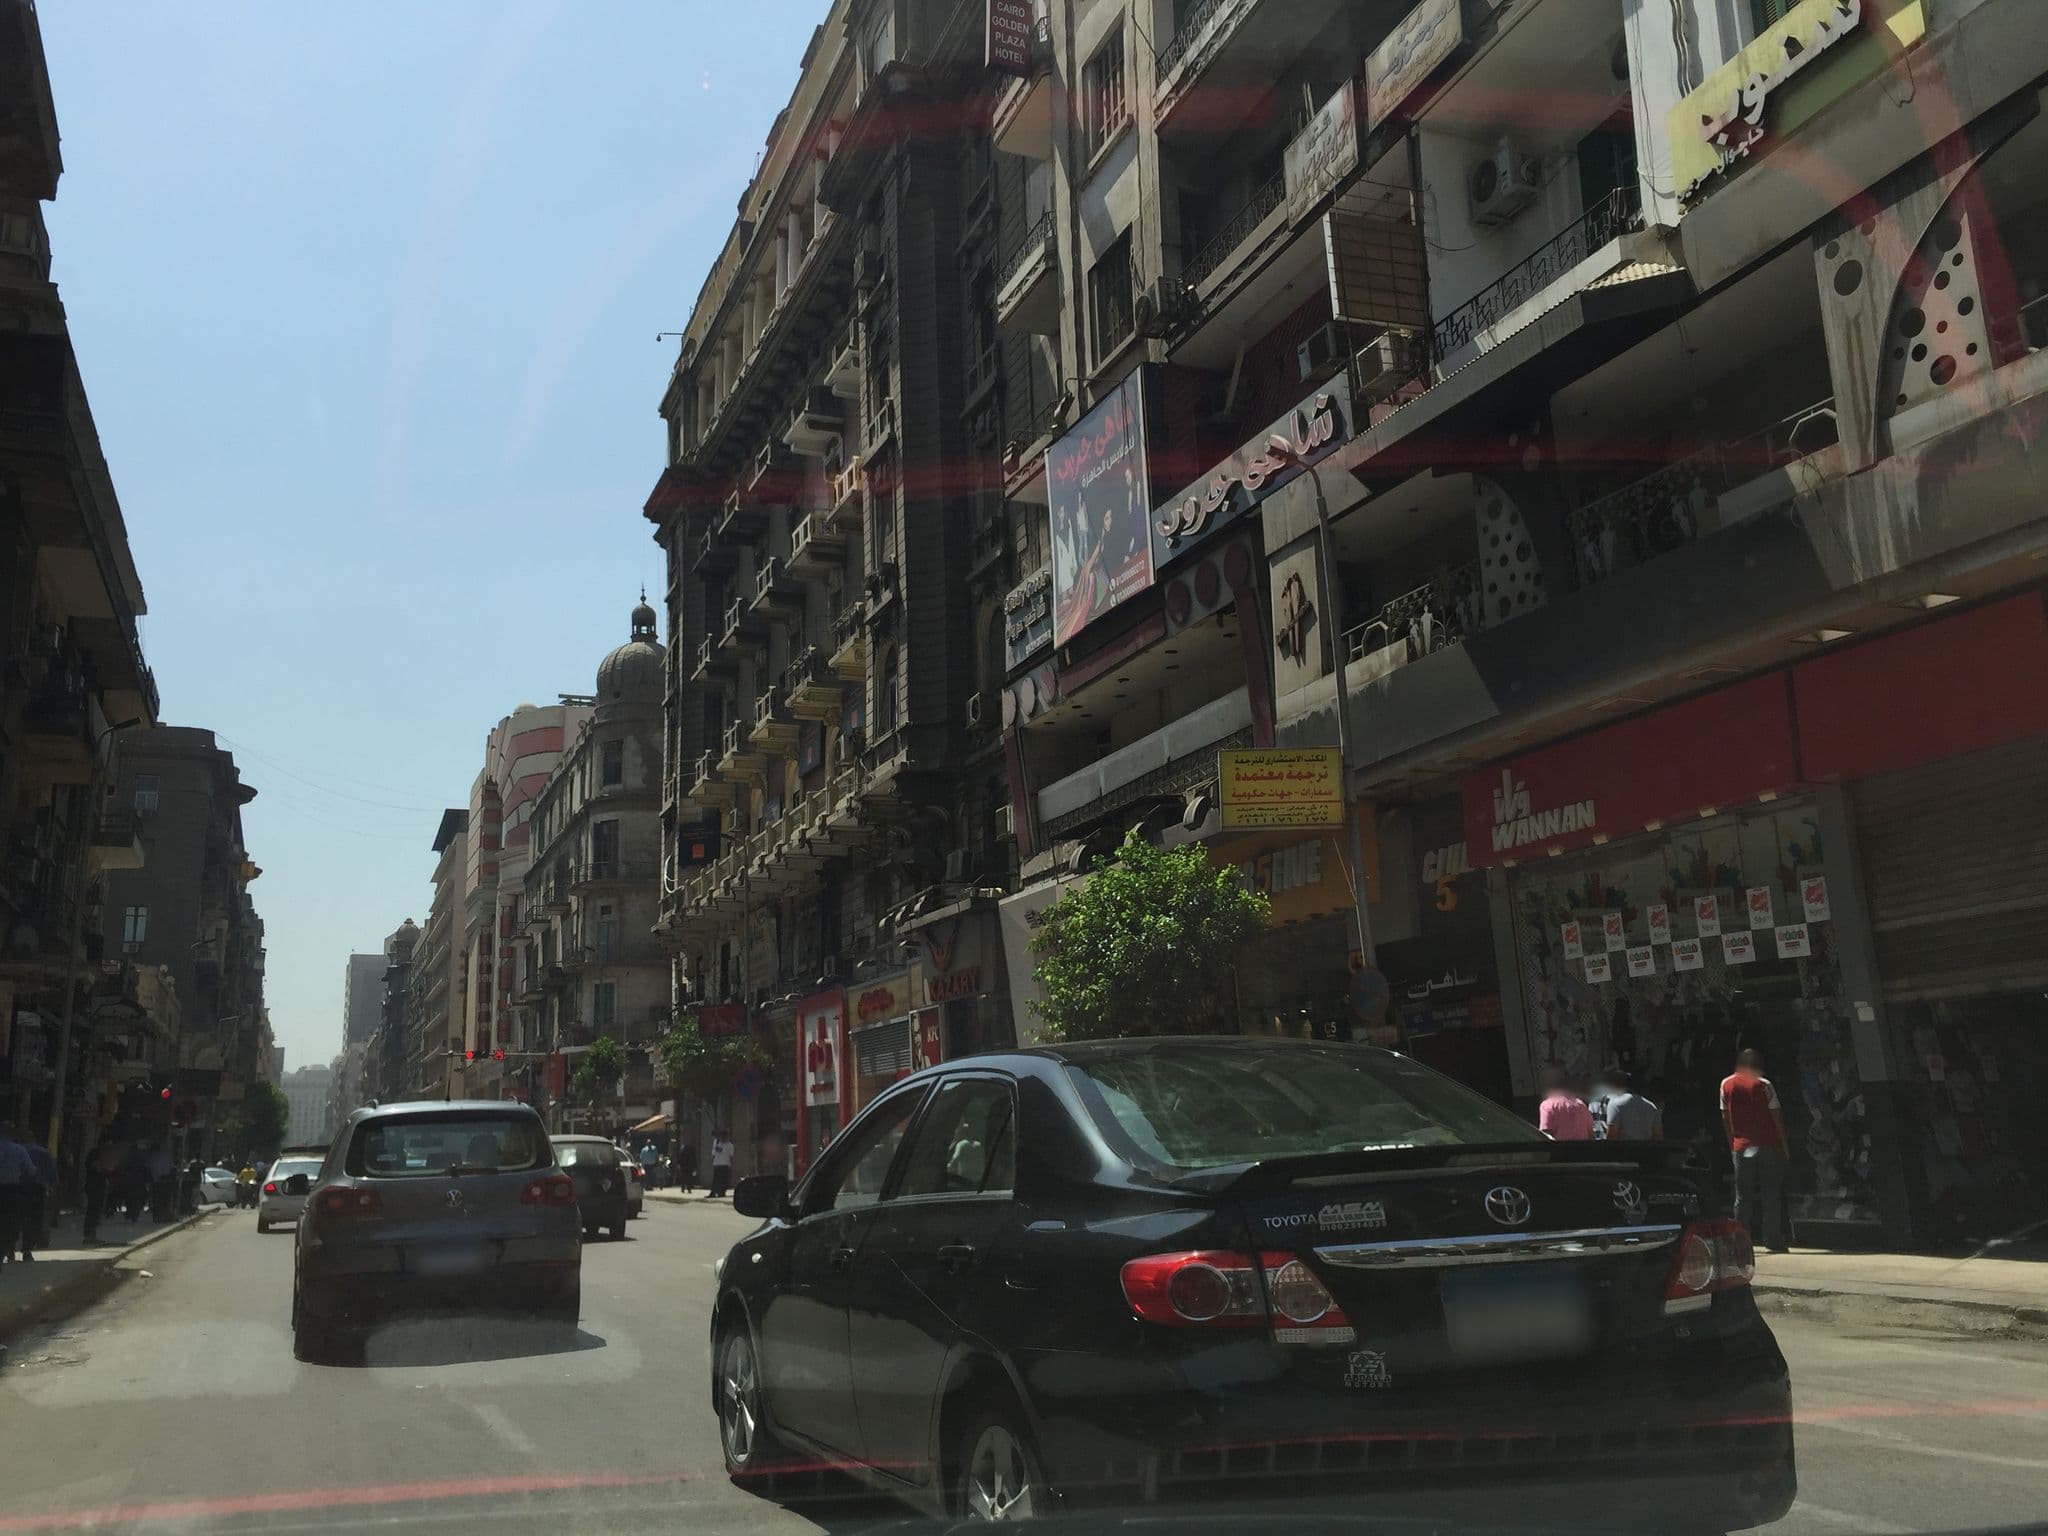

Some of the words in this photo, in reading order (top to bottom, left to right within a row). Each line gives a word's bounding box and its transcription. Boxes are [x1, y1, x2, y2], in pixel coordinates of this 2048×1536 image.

[997, 1, 1026, 18] CAIRO
[992, 15, 1030, 35] GOLDEN
[995, 31, 1026, 49] PLAZA
[995, 47, 1025, 65] HOTEL
[1234, 767, 1285, 783] معتمدة
[1286, 764, 1329, 783] ترجمة
[1491, 799, 1596, 852] WANNAN
[1263, 1213, 1319, 1229] TOYOTA
